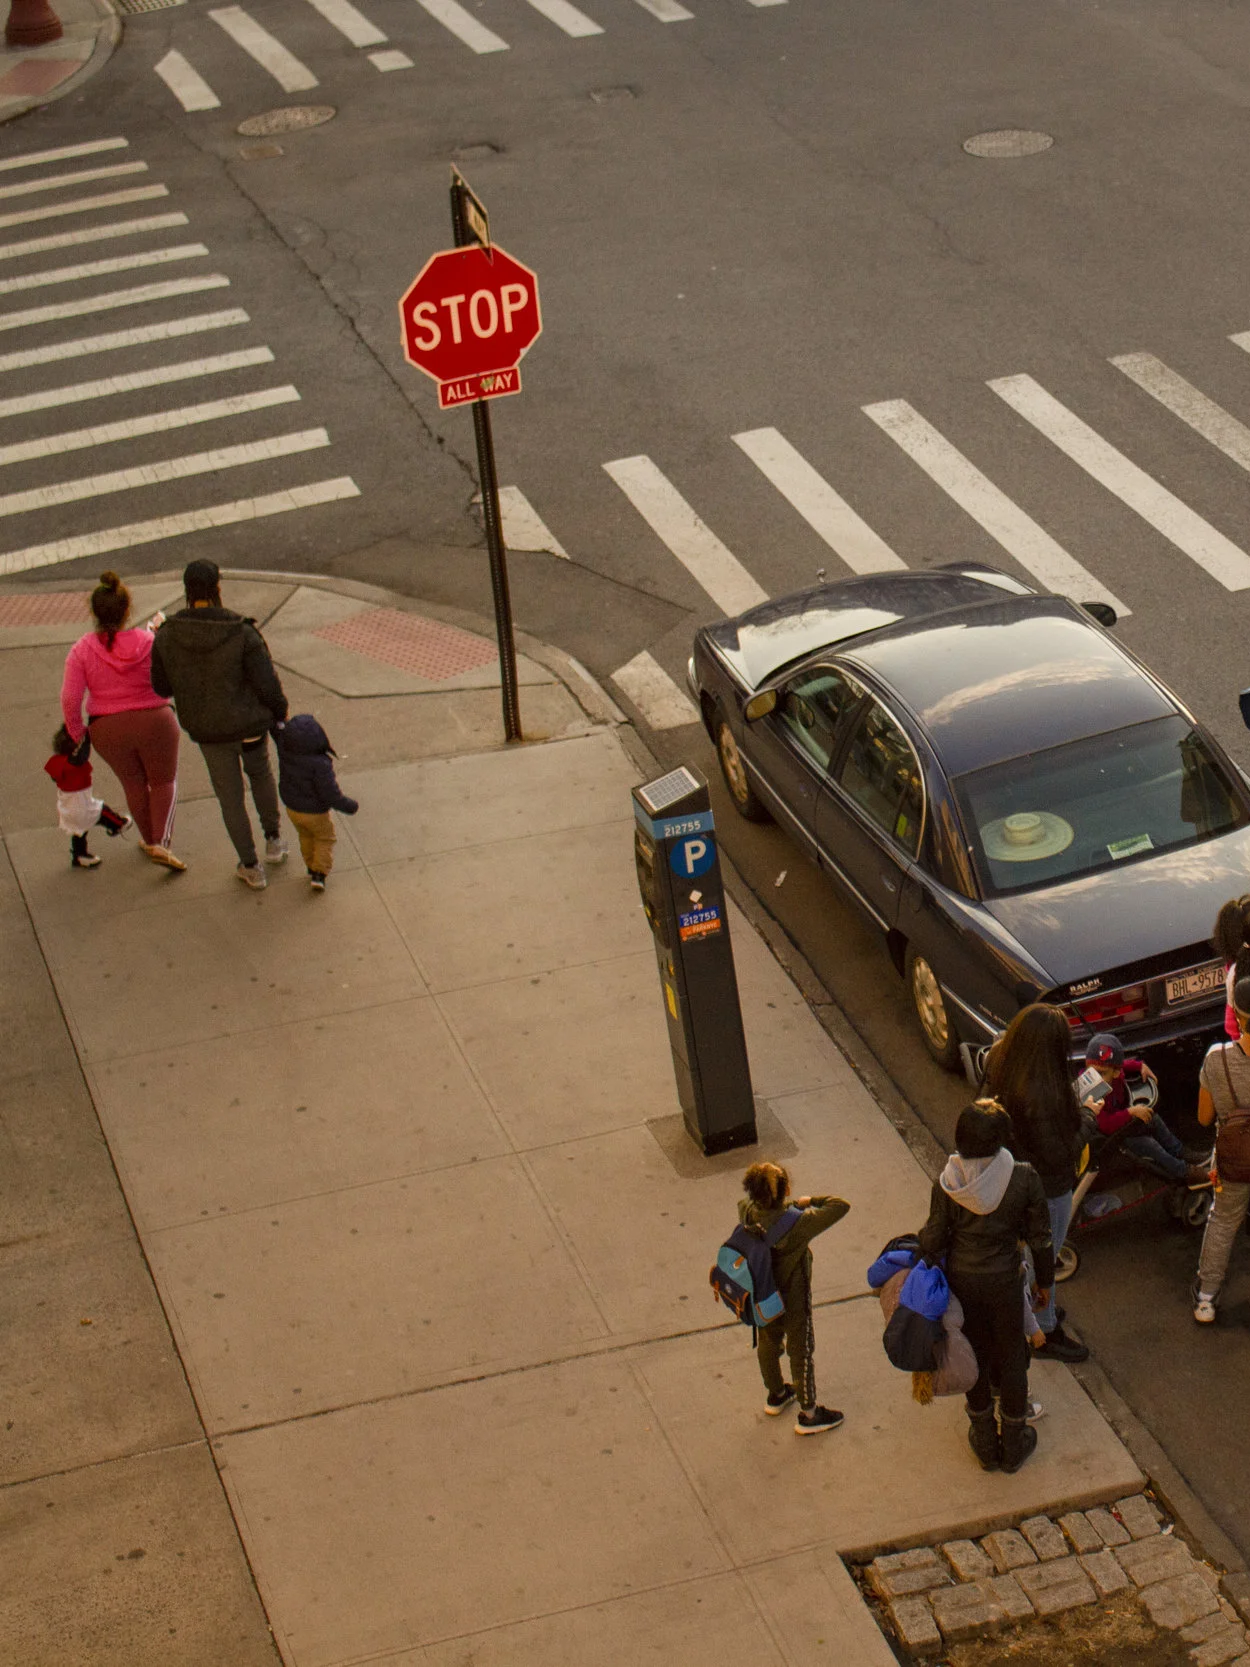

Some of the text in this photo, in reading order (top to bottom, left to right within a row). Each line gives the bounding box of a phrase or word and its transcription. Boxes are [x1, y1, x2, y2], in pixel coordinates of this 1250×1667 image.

[412, 283, 529, 351] STOP
[446, 372, 513, 402] ALL WAY
[664, 820, 701, 837] 212755
[684, 840, 707, 874] P
[683, 910, 717, 927] 212755
[1199, 970, 1224, 989] 9578
